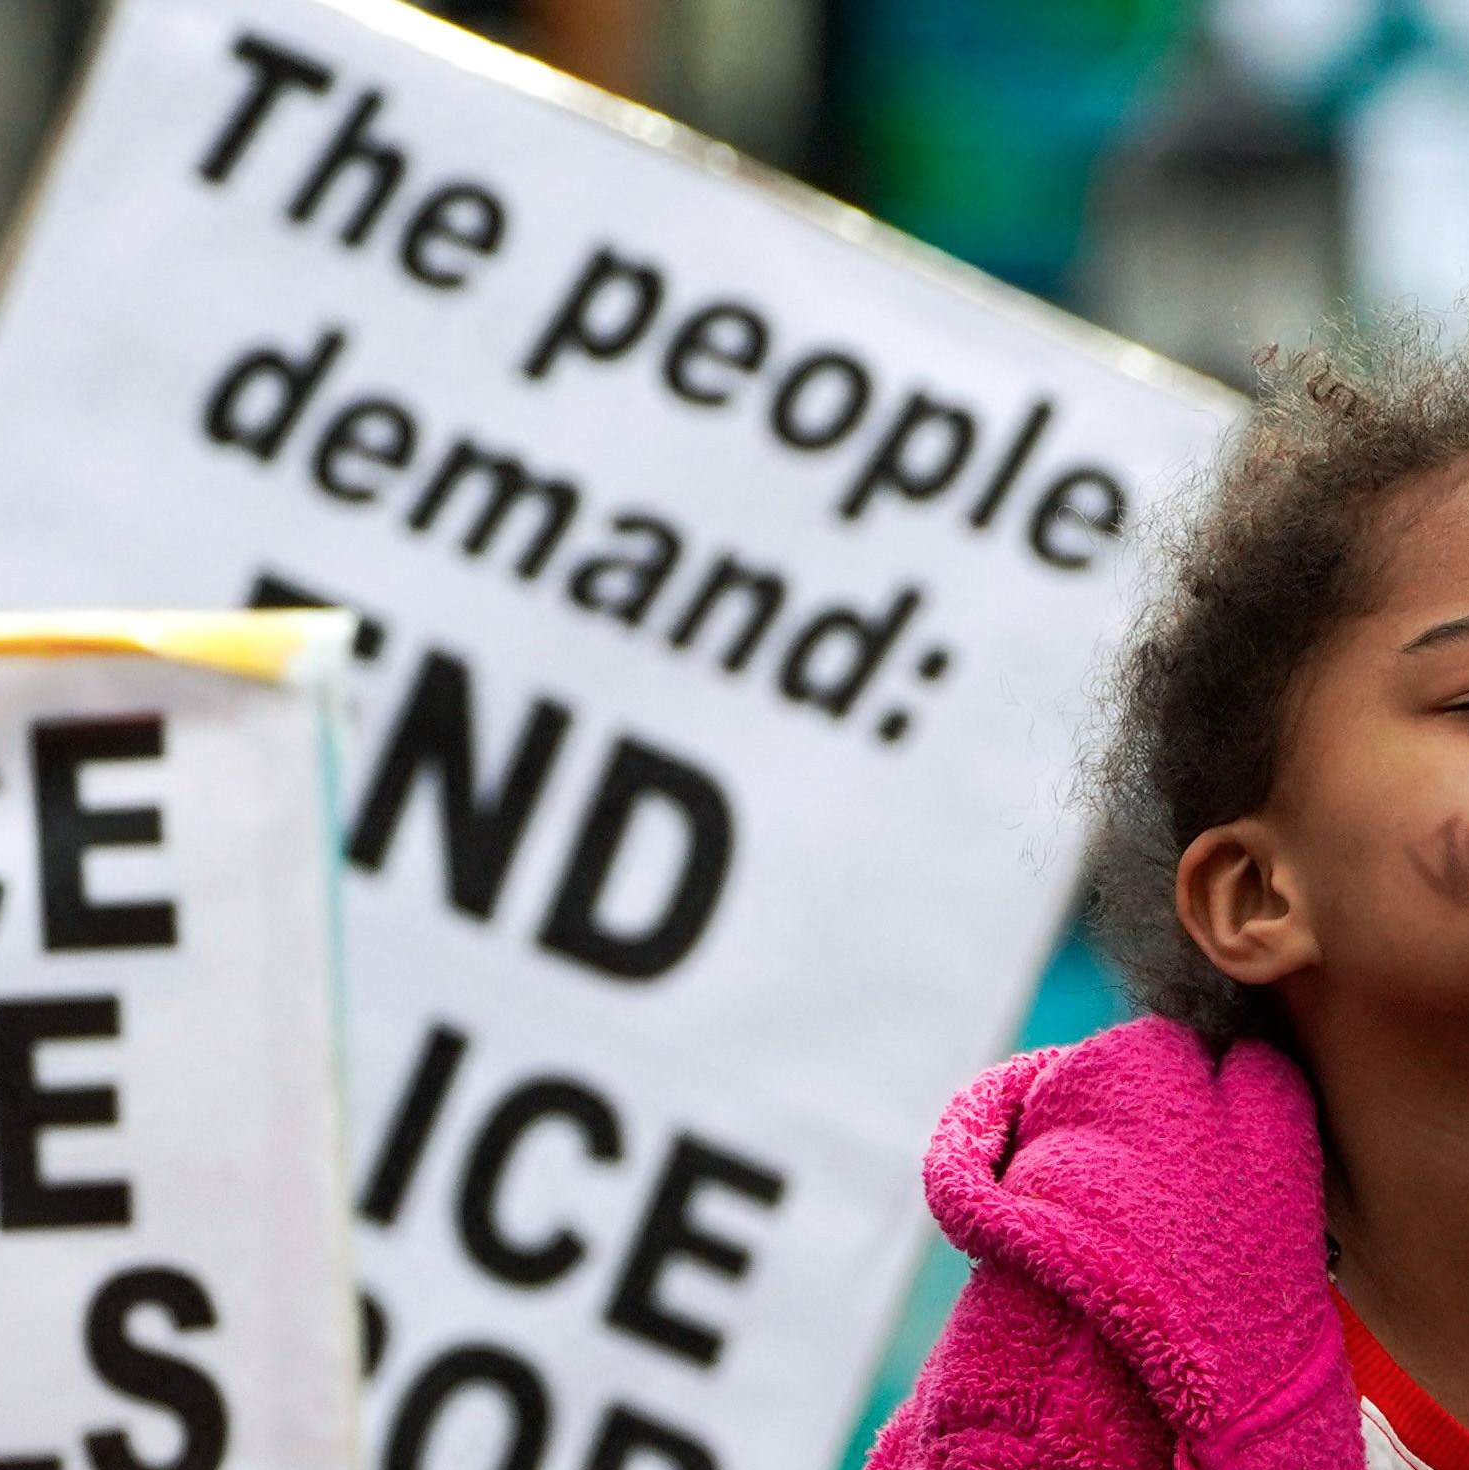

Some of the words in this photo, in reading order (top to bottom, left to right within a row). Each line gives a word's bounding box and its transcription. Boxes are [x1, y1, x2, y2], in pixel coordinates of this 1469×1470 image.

[198, 29, 509, 293] The
[521, 240, 1131, 570] people
[201, 325, 955, 747] demand:
